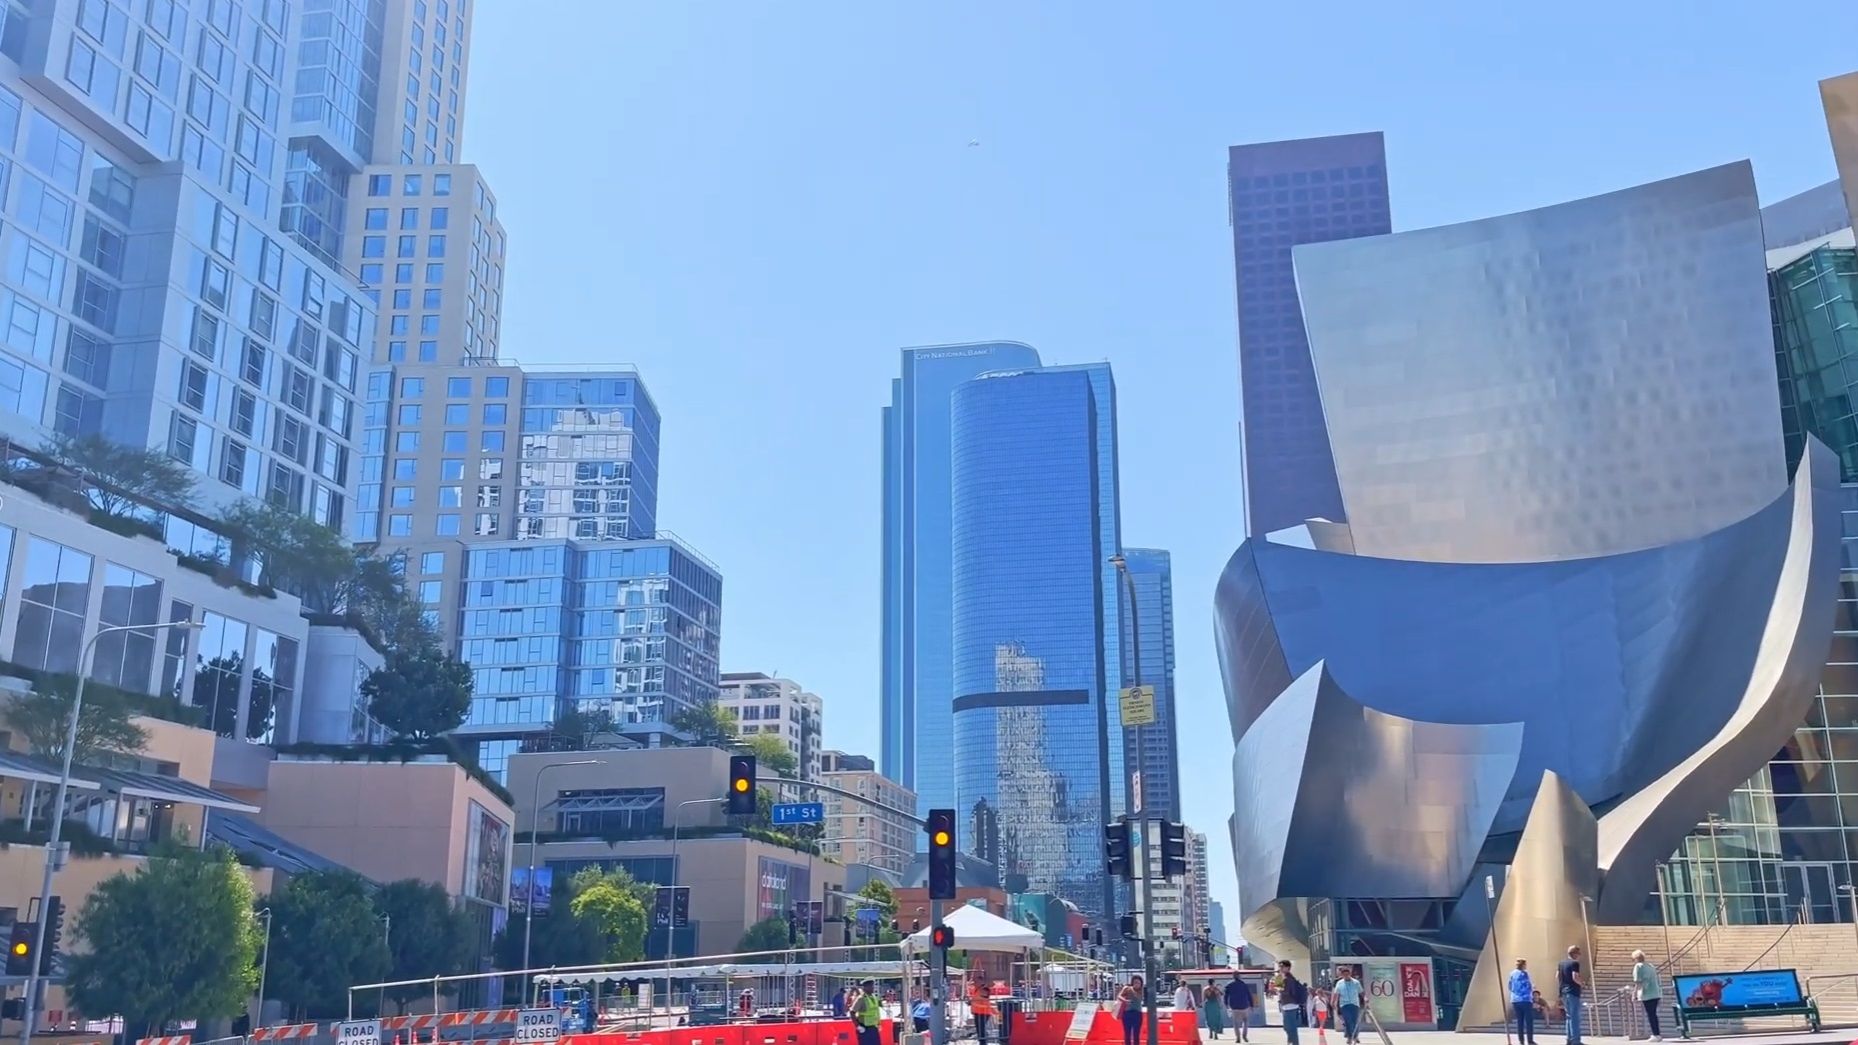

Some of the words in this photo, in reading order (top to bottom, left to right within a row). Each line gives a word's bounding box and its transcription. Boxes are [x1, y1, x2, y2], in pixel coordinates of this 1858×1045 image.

[780, 808, 796, 820] 1st
[801, 808, 816, 818] St
[1370, 980, 1394, 997] 60
[523, 1014, 554, 1025] ROAD
[344, 1025, 374, 1037] ROAD
[517, 1027, 559, 1039] CLOSED
